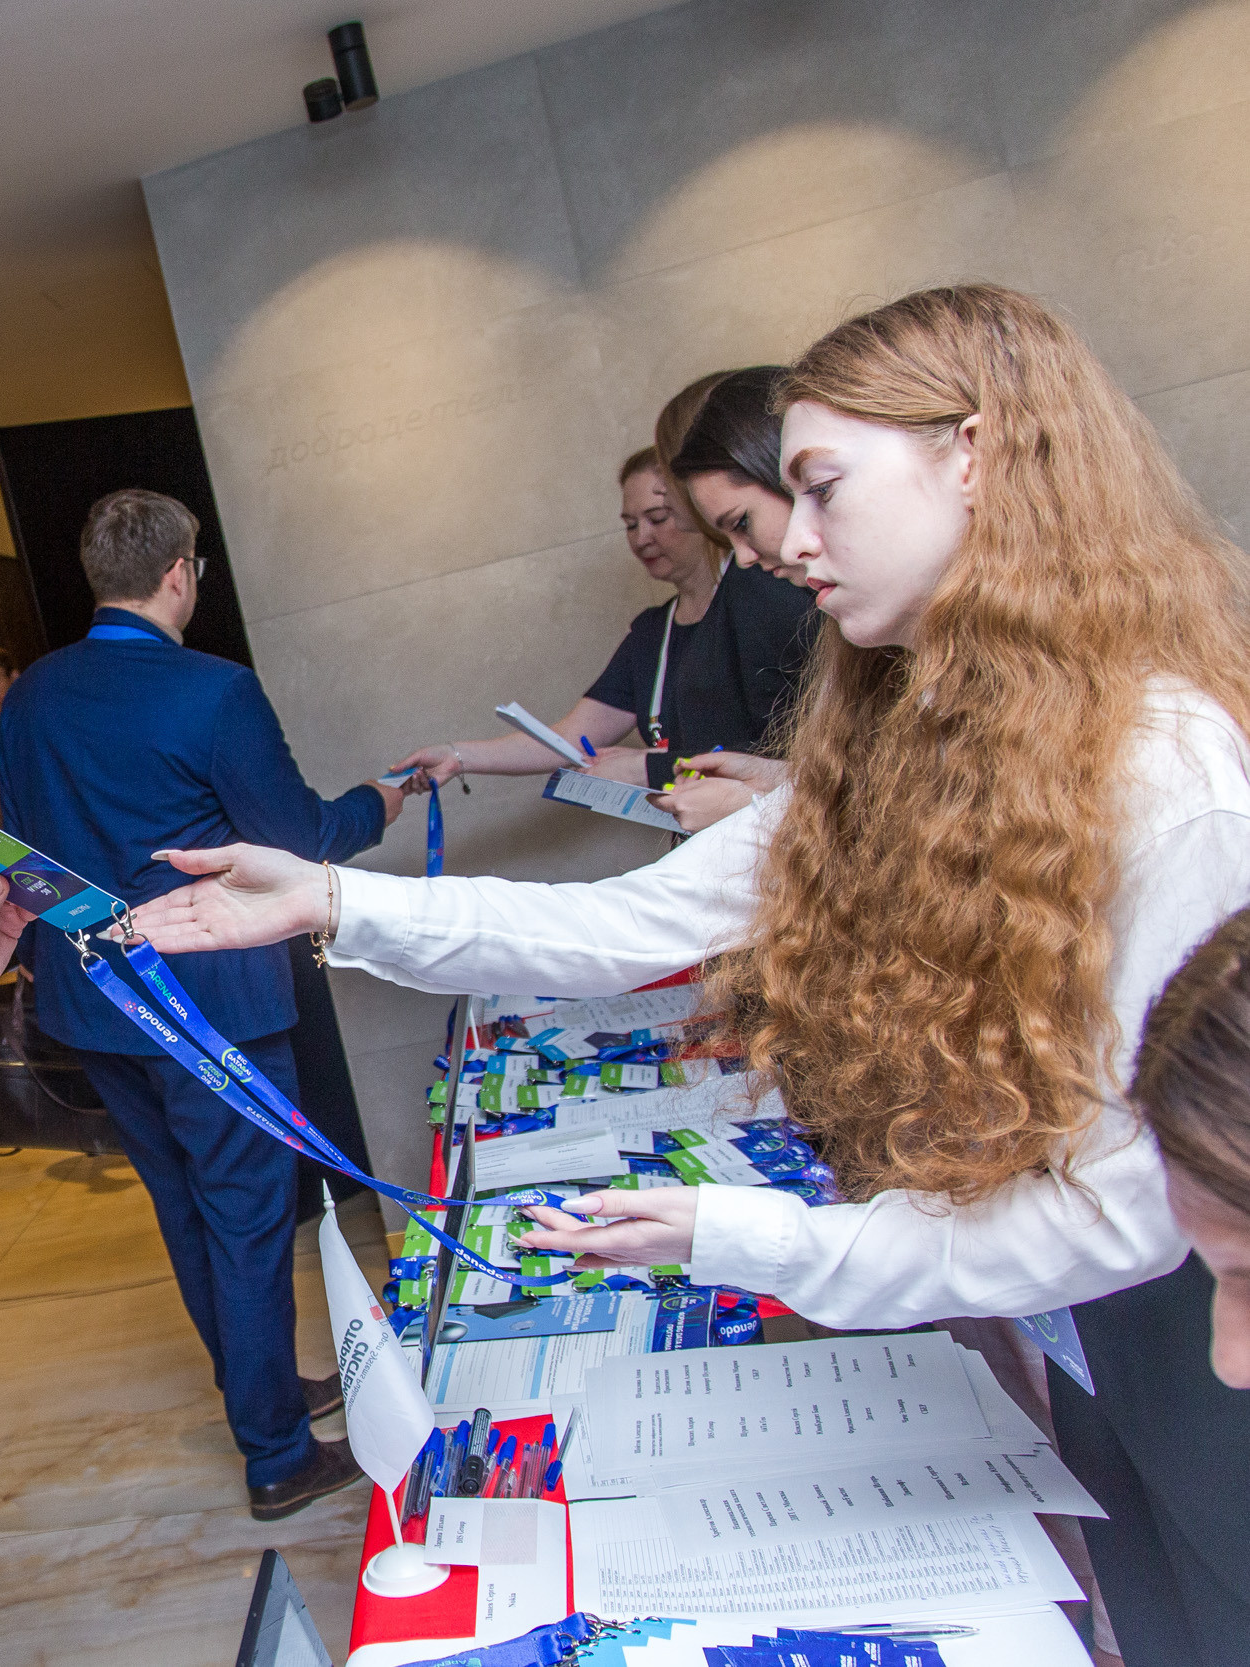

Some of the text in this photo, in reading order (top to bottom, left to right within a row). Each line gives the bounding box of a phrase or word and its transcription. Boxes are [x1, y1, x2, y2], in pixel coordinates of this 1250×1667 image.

[148, 970, 188, 1020] ARENADATA
[137, 1005, 178, 1043] denodo
[236, 1054, 248, 1065] BIG
[207, 1065, 223, 1079] 2022
[228, 1063, 244, 1076] 2022
[200, 1075, 212, 1085] BIG
[455, 1248, 504, 1280] denodo
[720, 1320, 758, 1338] denodo
